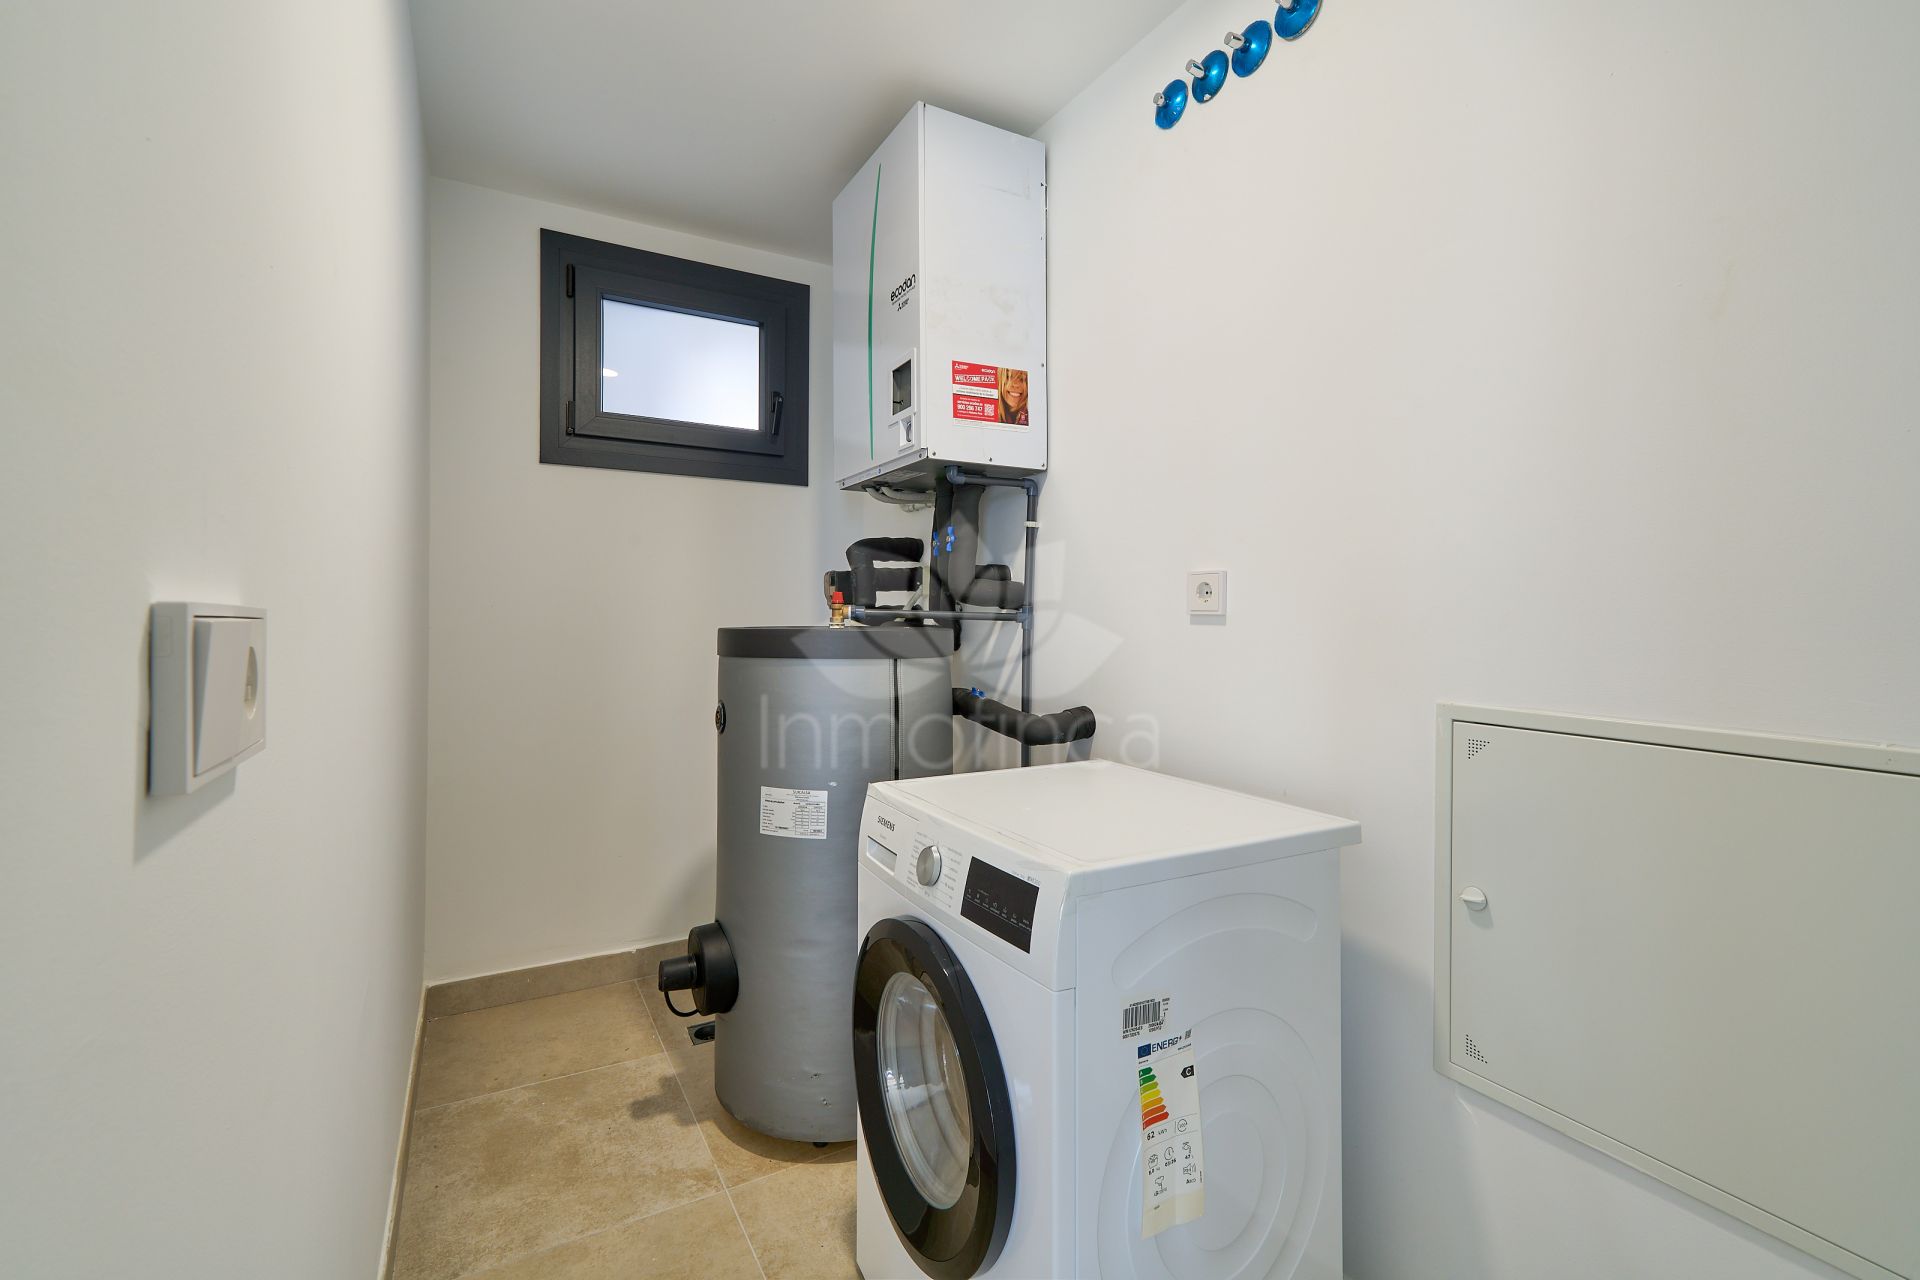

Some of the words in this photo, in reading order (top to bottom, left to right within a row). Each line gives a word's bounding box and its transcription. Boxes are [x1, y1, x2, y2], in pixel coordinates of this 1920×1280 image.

[890, 273, 916, 302] ecodan
[954, 374, 981, 383] WELCOME
[877, 815, 895, 832] SIEMENS
[1151, 1037, 1179, 1054] ENERG
[1185, 1067, 1192, 1076] C
[1146, 1131, 1155, 1141] 62
